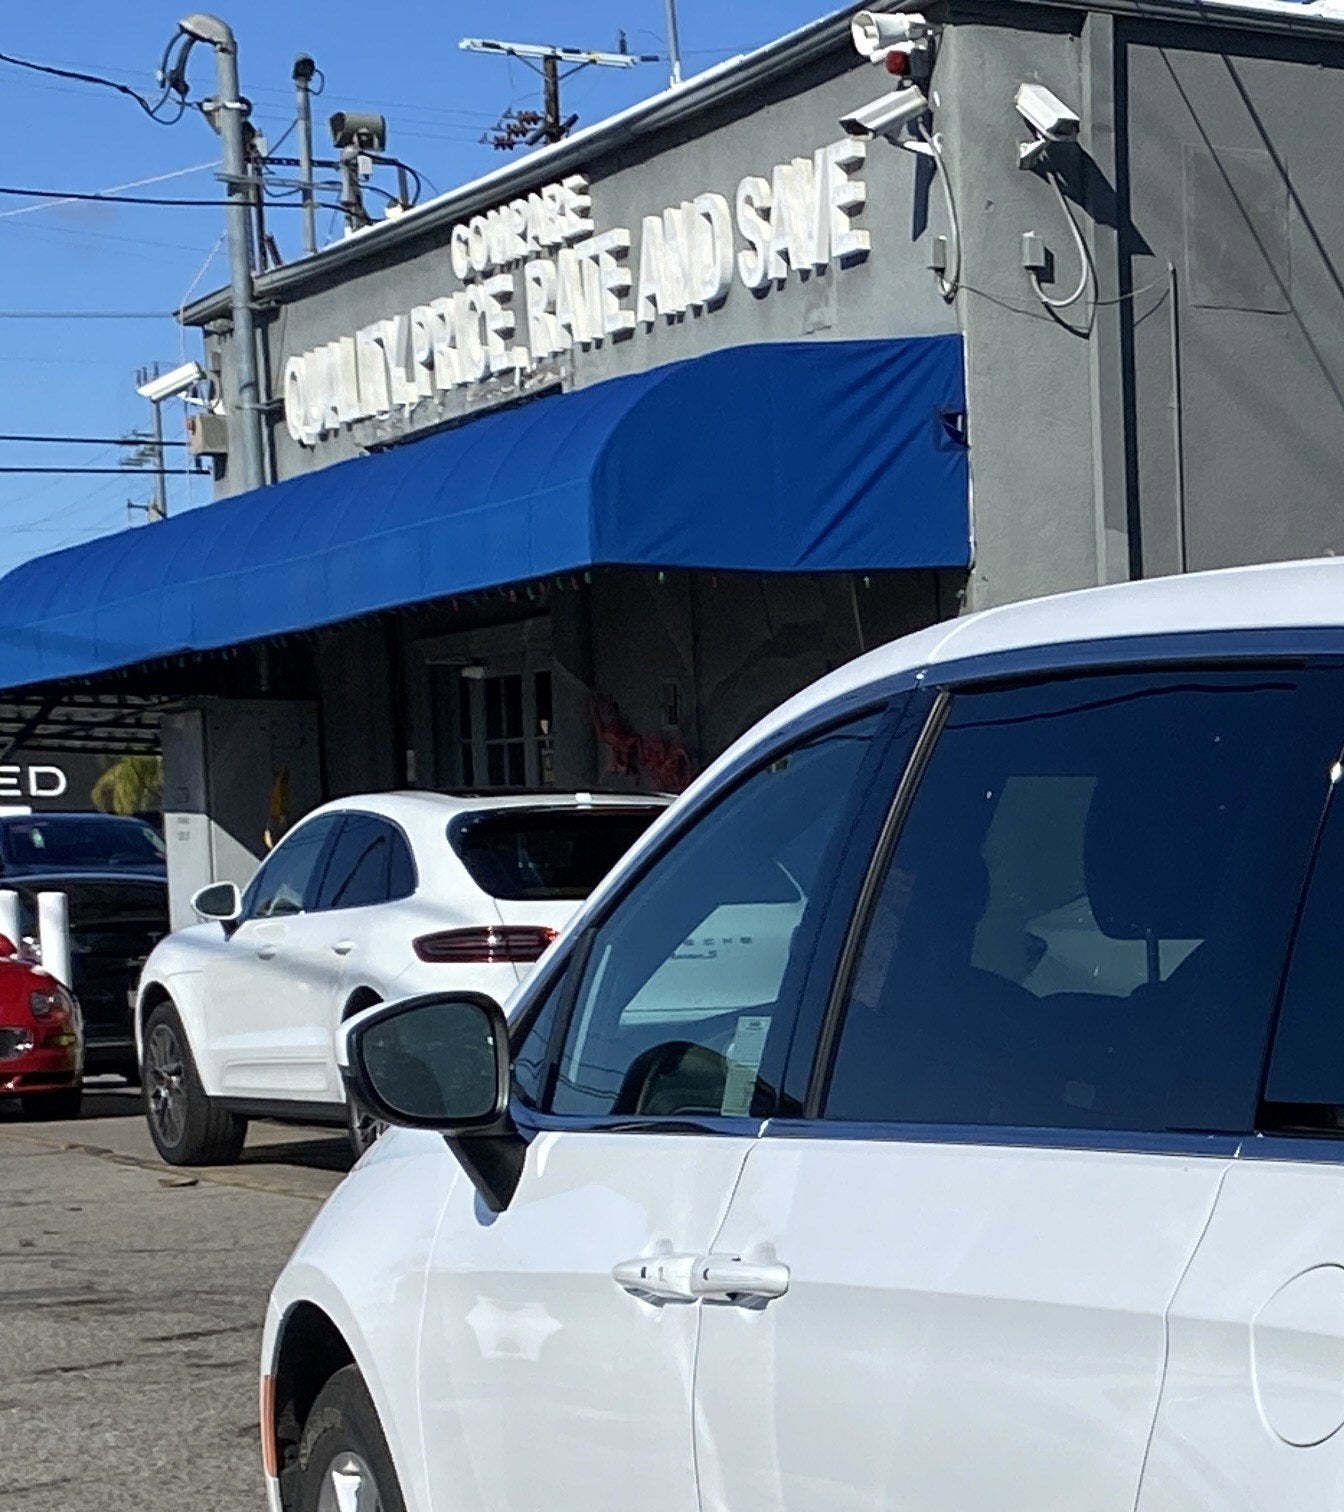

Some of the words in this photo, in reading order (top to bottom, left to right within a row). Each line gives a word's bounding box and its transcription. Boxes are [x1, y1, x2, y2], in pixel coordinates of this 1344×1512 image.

[284, 314, 419, 445] QUALITY
[525, 227, 636, 358] RATE
[637, 192, 735, 322] AND
[736, 138, 872, 288] SAVE
[451, 174, 594, 279] COMPARE
